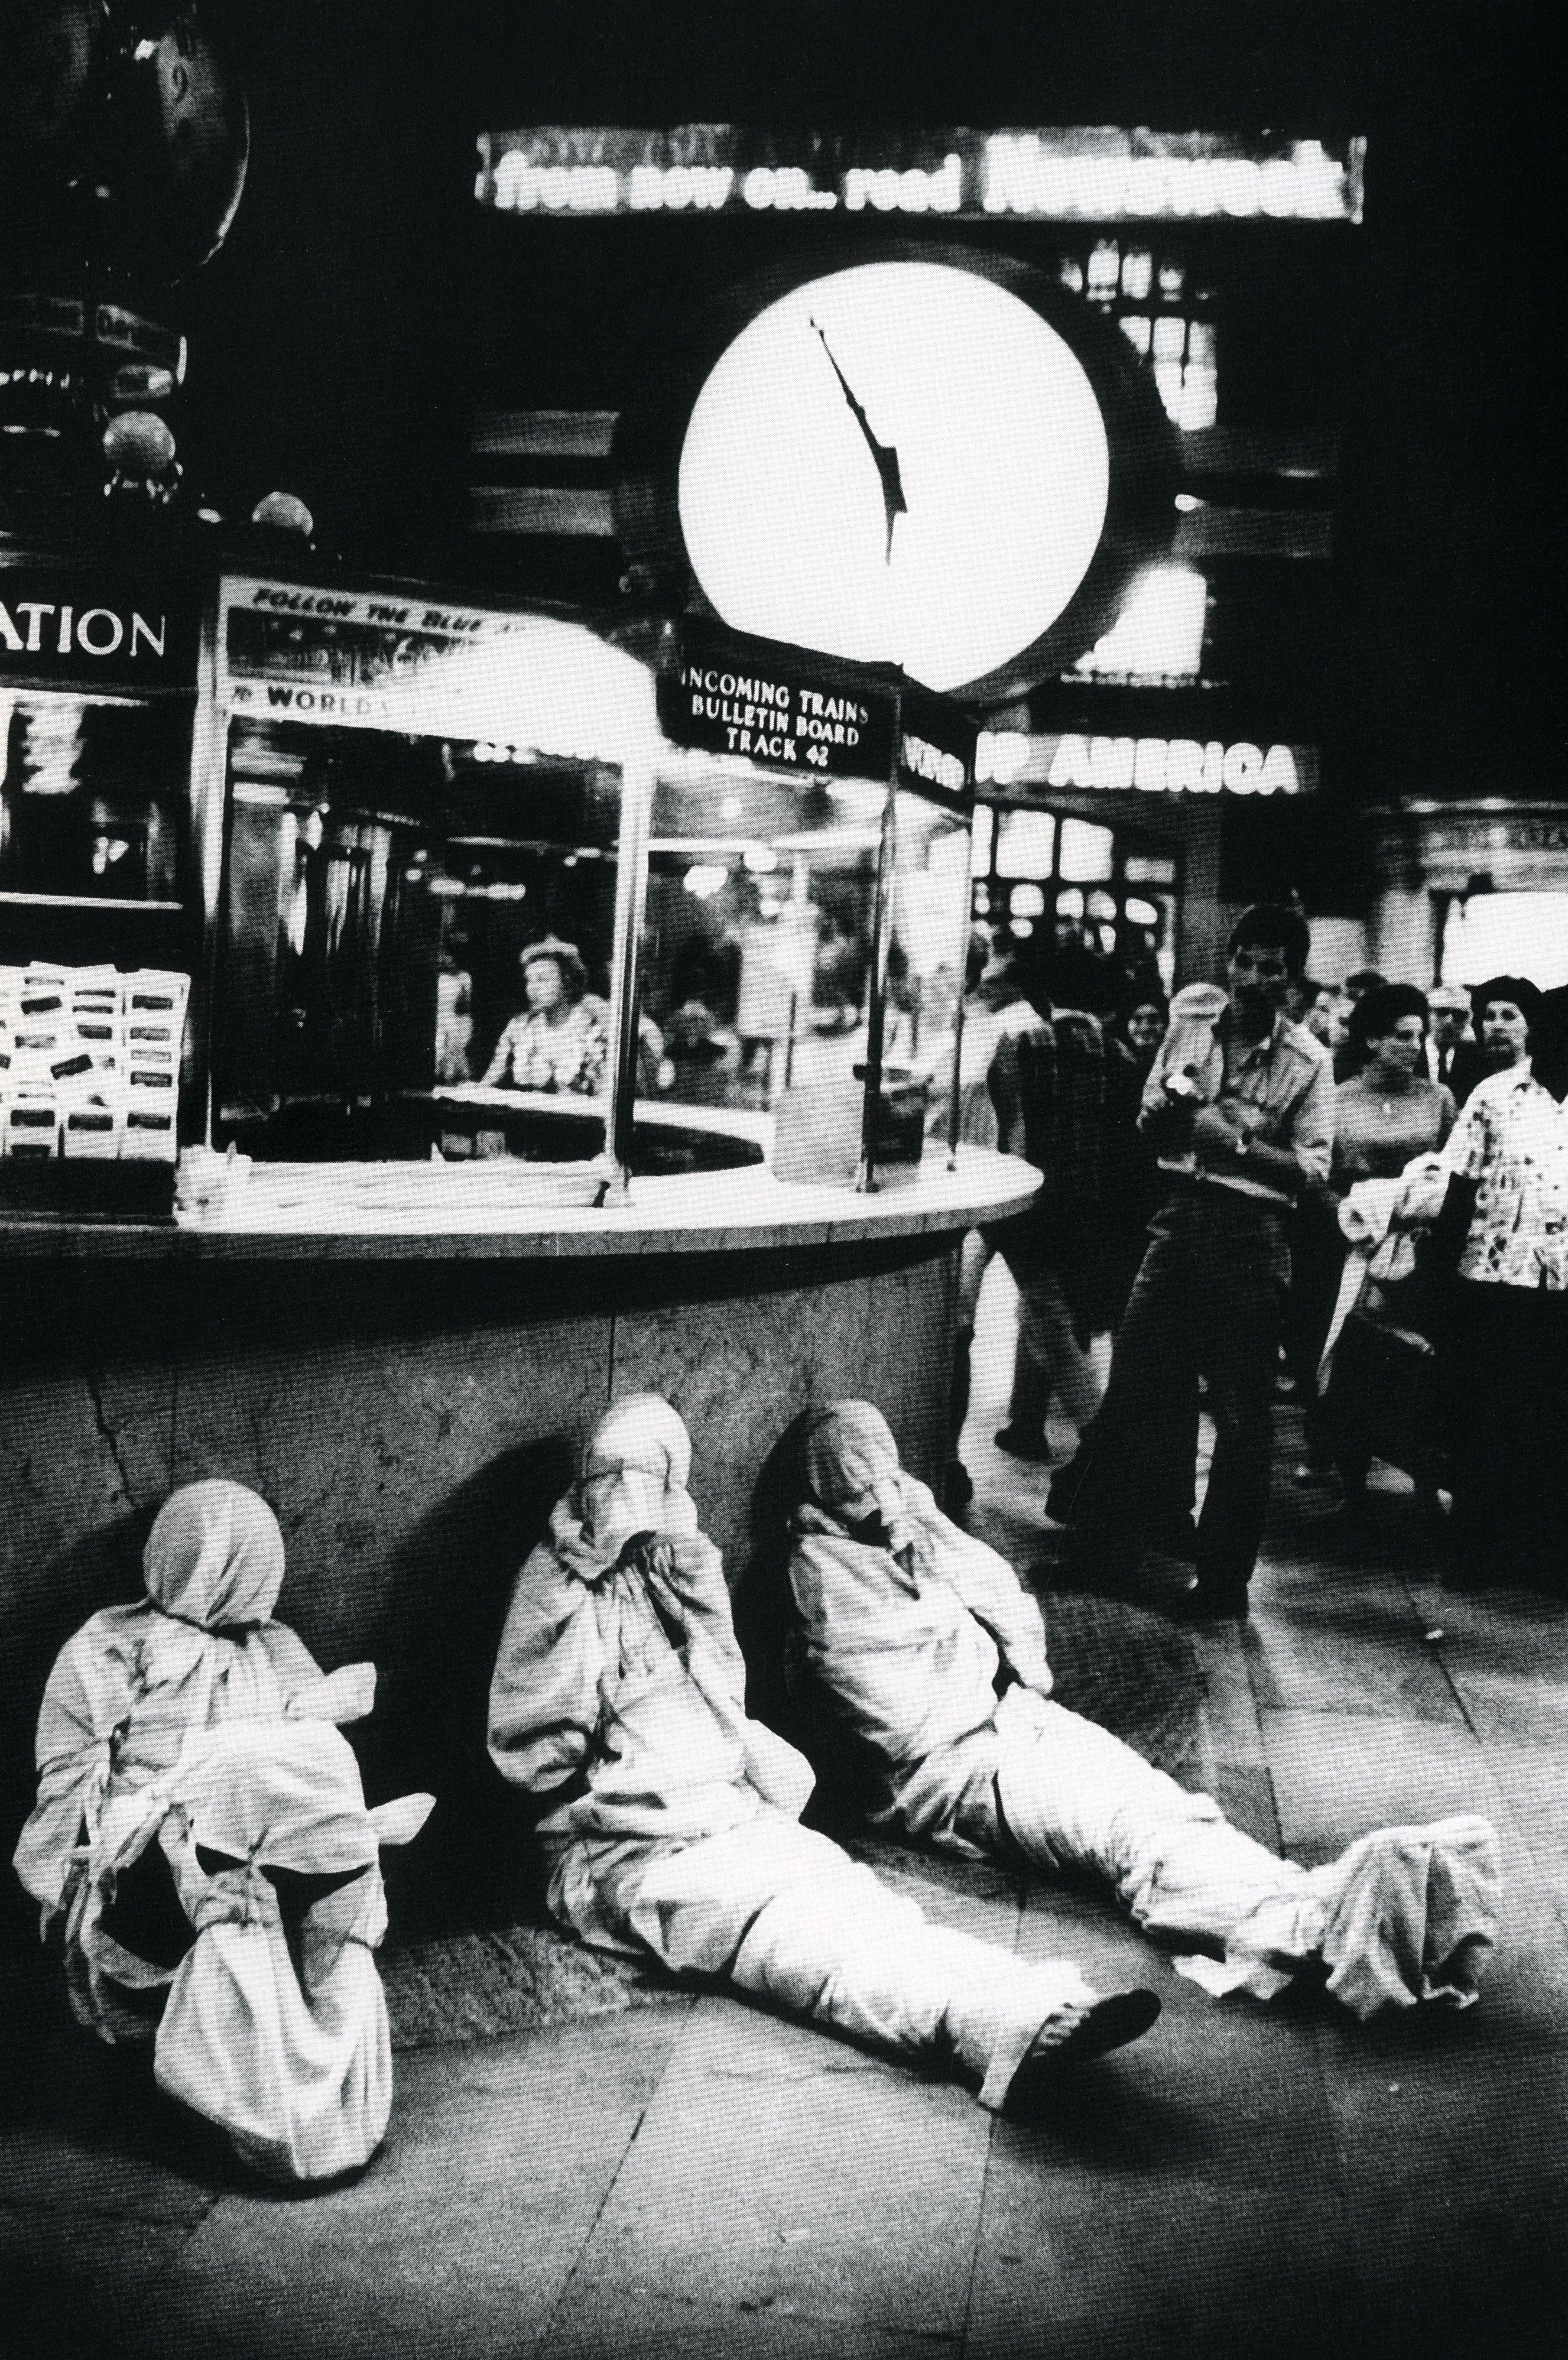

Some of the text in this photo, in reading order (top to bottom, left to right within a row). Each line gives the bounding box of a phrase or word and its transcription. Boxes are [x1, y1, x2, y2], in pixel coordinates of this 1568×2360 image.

[681, 667, 868, 724] INCOMING TRAINS
[692, 695, 859, 747] BULLETIN BOARD
[727, 727, 829, 767] TRACK 42
[1048, 734, 1299, 795] AMERICA
